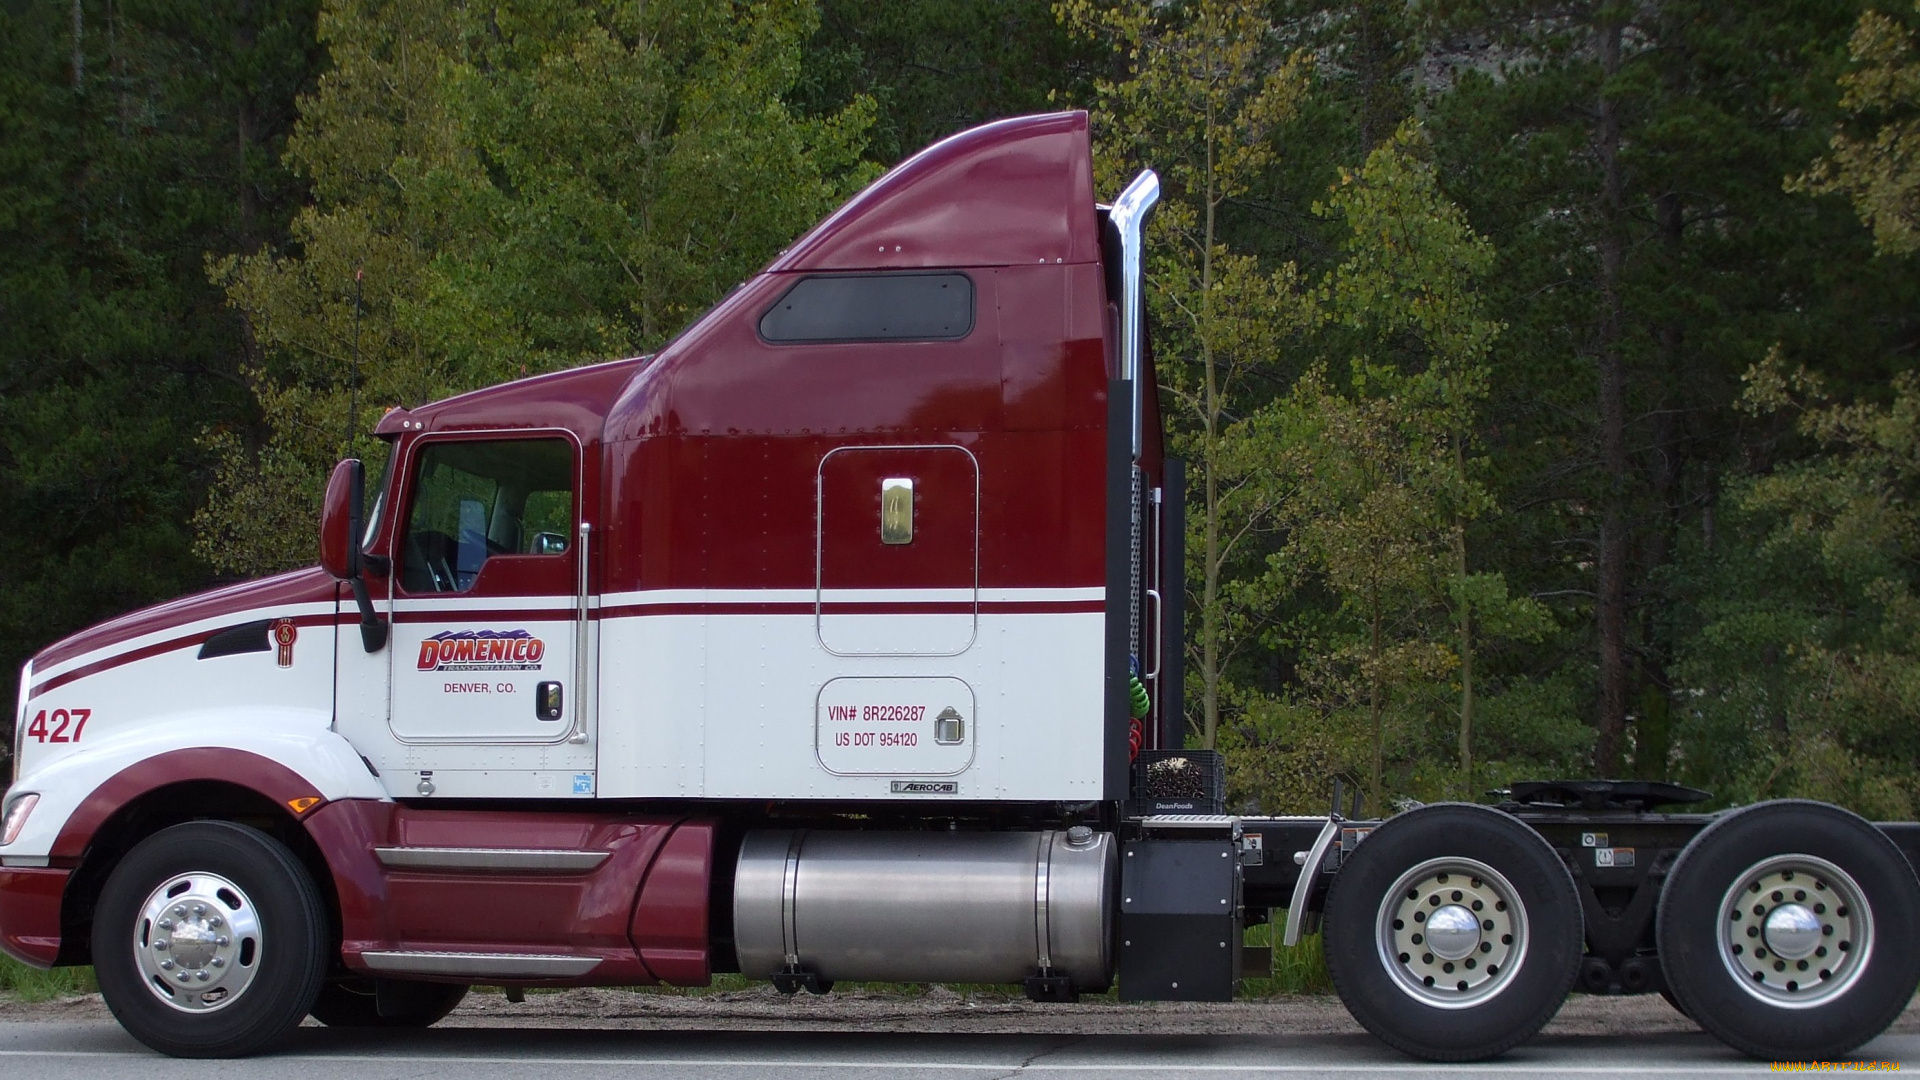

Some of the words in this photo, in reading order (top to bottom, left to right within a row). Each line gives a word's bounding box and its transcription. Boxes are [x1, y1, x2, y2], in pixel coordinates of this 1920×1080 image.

[416, 639, 545, 671] DOMENICO
[444, 683, 492, 694] DENVER,
[496, 683, 516, 693] CO.
[828, 706, 857, 721] VIN#
[863, 706, 926, 721] 8R226287
[27, 708, 92, 743] 427
[835, 733, 850, 746] US
[854, 733, 876, 746] DOT
[879, 733, 918, 746] 954120
[903, 783, 953, 791] AEROCAB
